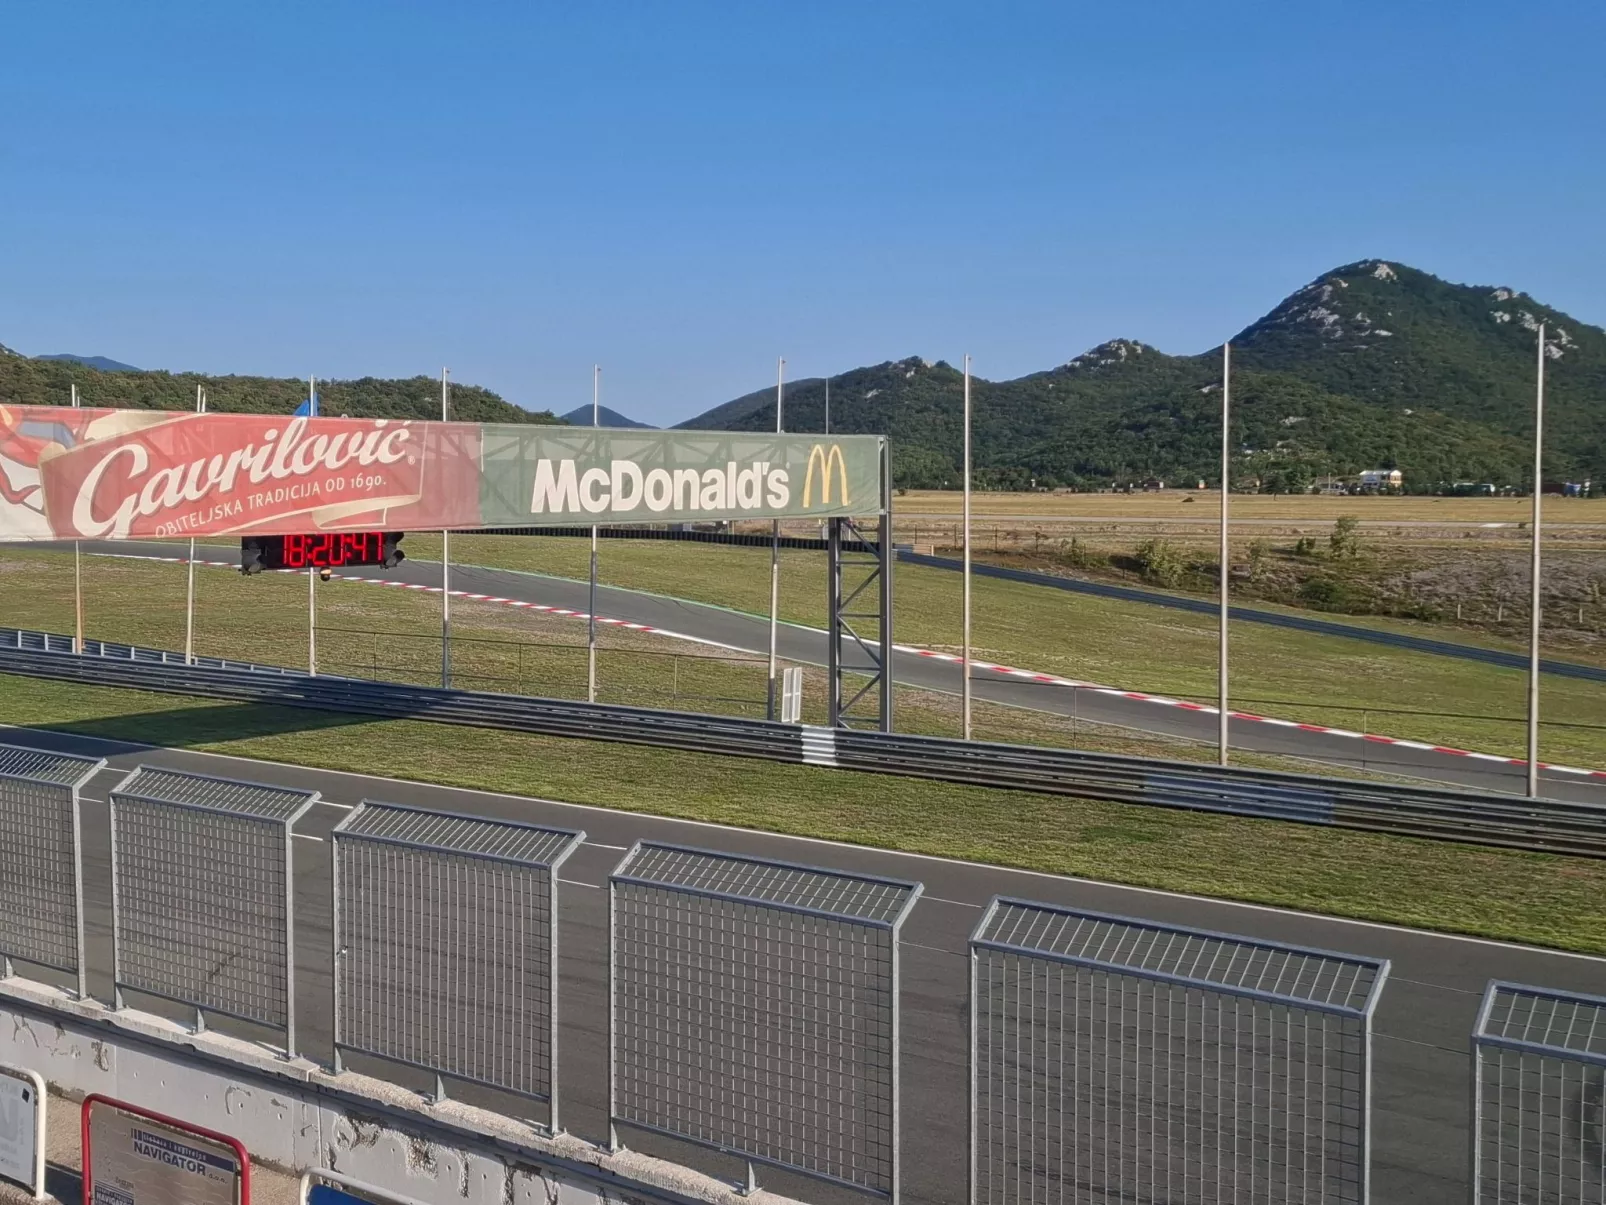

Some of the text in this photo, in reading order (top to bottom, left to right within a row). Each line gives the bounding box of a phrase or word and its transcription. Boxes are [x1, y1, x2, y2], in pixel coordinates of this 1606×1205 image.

[72, 416, 411, 539] Gavrilović
[531, 458, 790, 513] McDonald's
[155, 498, 243, 539] OBITELJSKA
[246, 481, 321, 511] TRADICIJA
[325, 477, 345, 493] OD
[133, 1141, 206, 1176] NAVIGATOR
